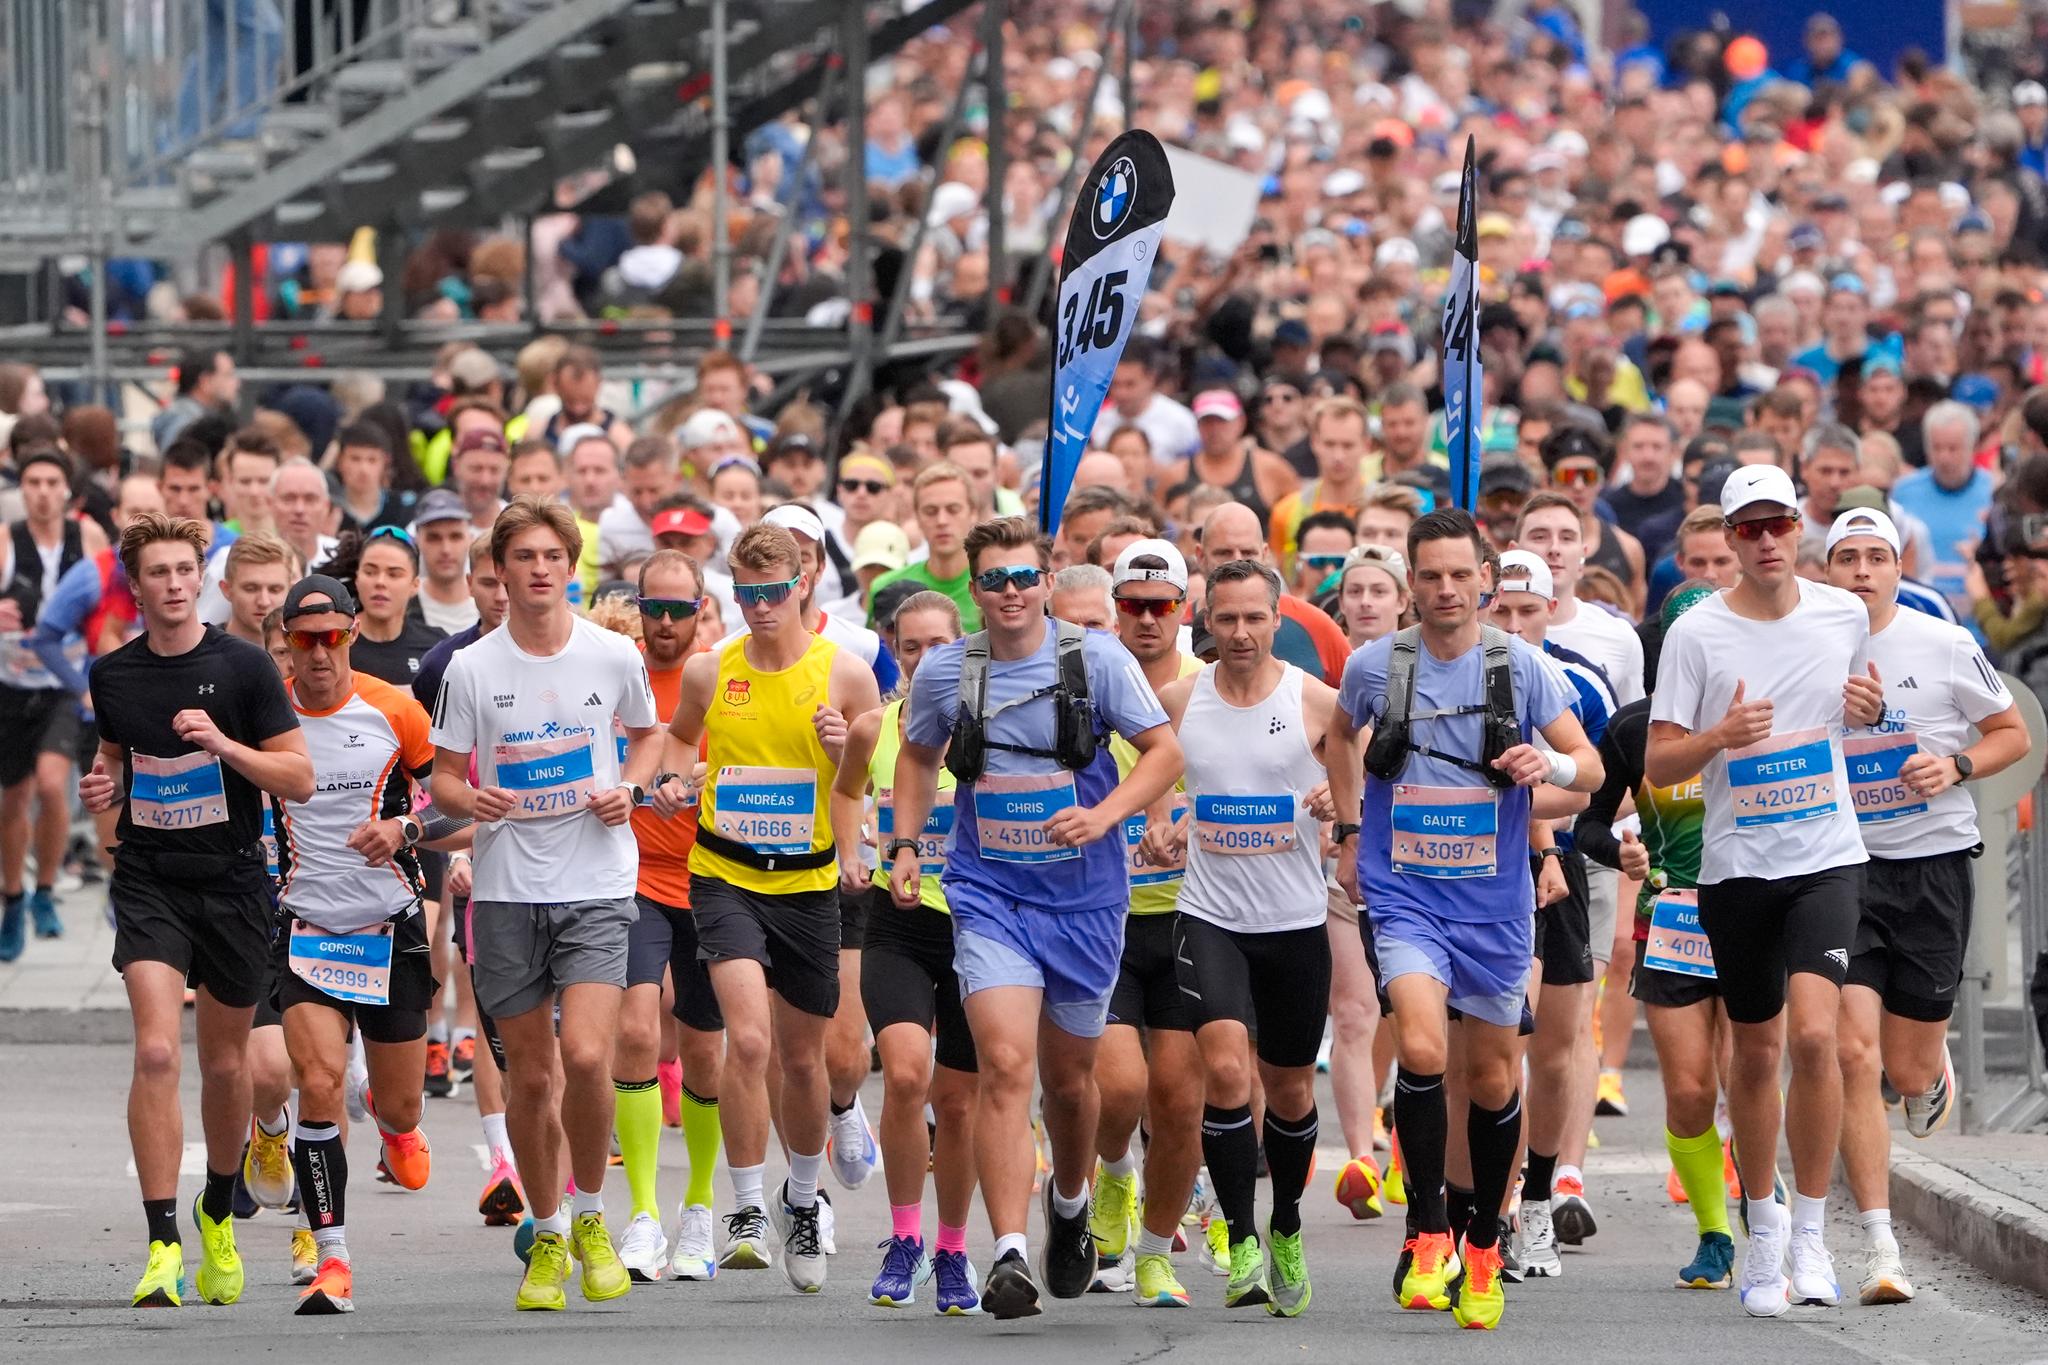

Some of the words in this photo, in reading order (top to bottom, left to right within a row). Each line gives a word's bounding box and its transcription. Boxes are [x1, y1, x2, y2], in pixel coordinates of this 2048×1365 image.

[1100, 161, 1133, 189] BMW
[1059, 269, 1129, 370] 3.45
[493, 694, 515, 702] REMA
[504, 731, 534, 742] BMW
[527, 766, 565, 781] LINUS
[1756, 758, 1807, 775] PETTER
[1856, 762, 1882, 775] OLA
[157, 783, 189, 796] HAUK
[316, 781, 373, 791] LANDA
[1672, 783, 1702, 800] LIE
[523, 789, 577, 812] 42718
[737, 792, 795, 806] ANDRÉAS
[1755, 783, 1817, 807] 42027
[151, 805, 203, 826] 42717
[1006, 802, 1045, 813] CHRIS
[1211, 803, 1277, 816] CHRISTIAN
[738, 820, 792, 837] 41666
[1422, 814, 1467, 827] GAUTE
[1213, 830, 1276, 848] 40984
[1413, 841, 1475, 860] 43097
[319, 942, 364, 957] CORSIN
[1671, 938, 1713, 959] 4010
[310, 966, 368, 988] 42999
